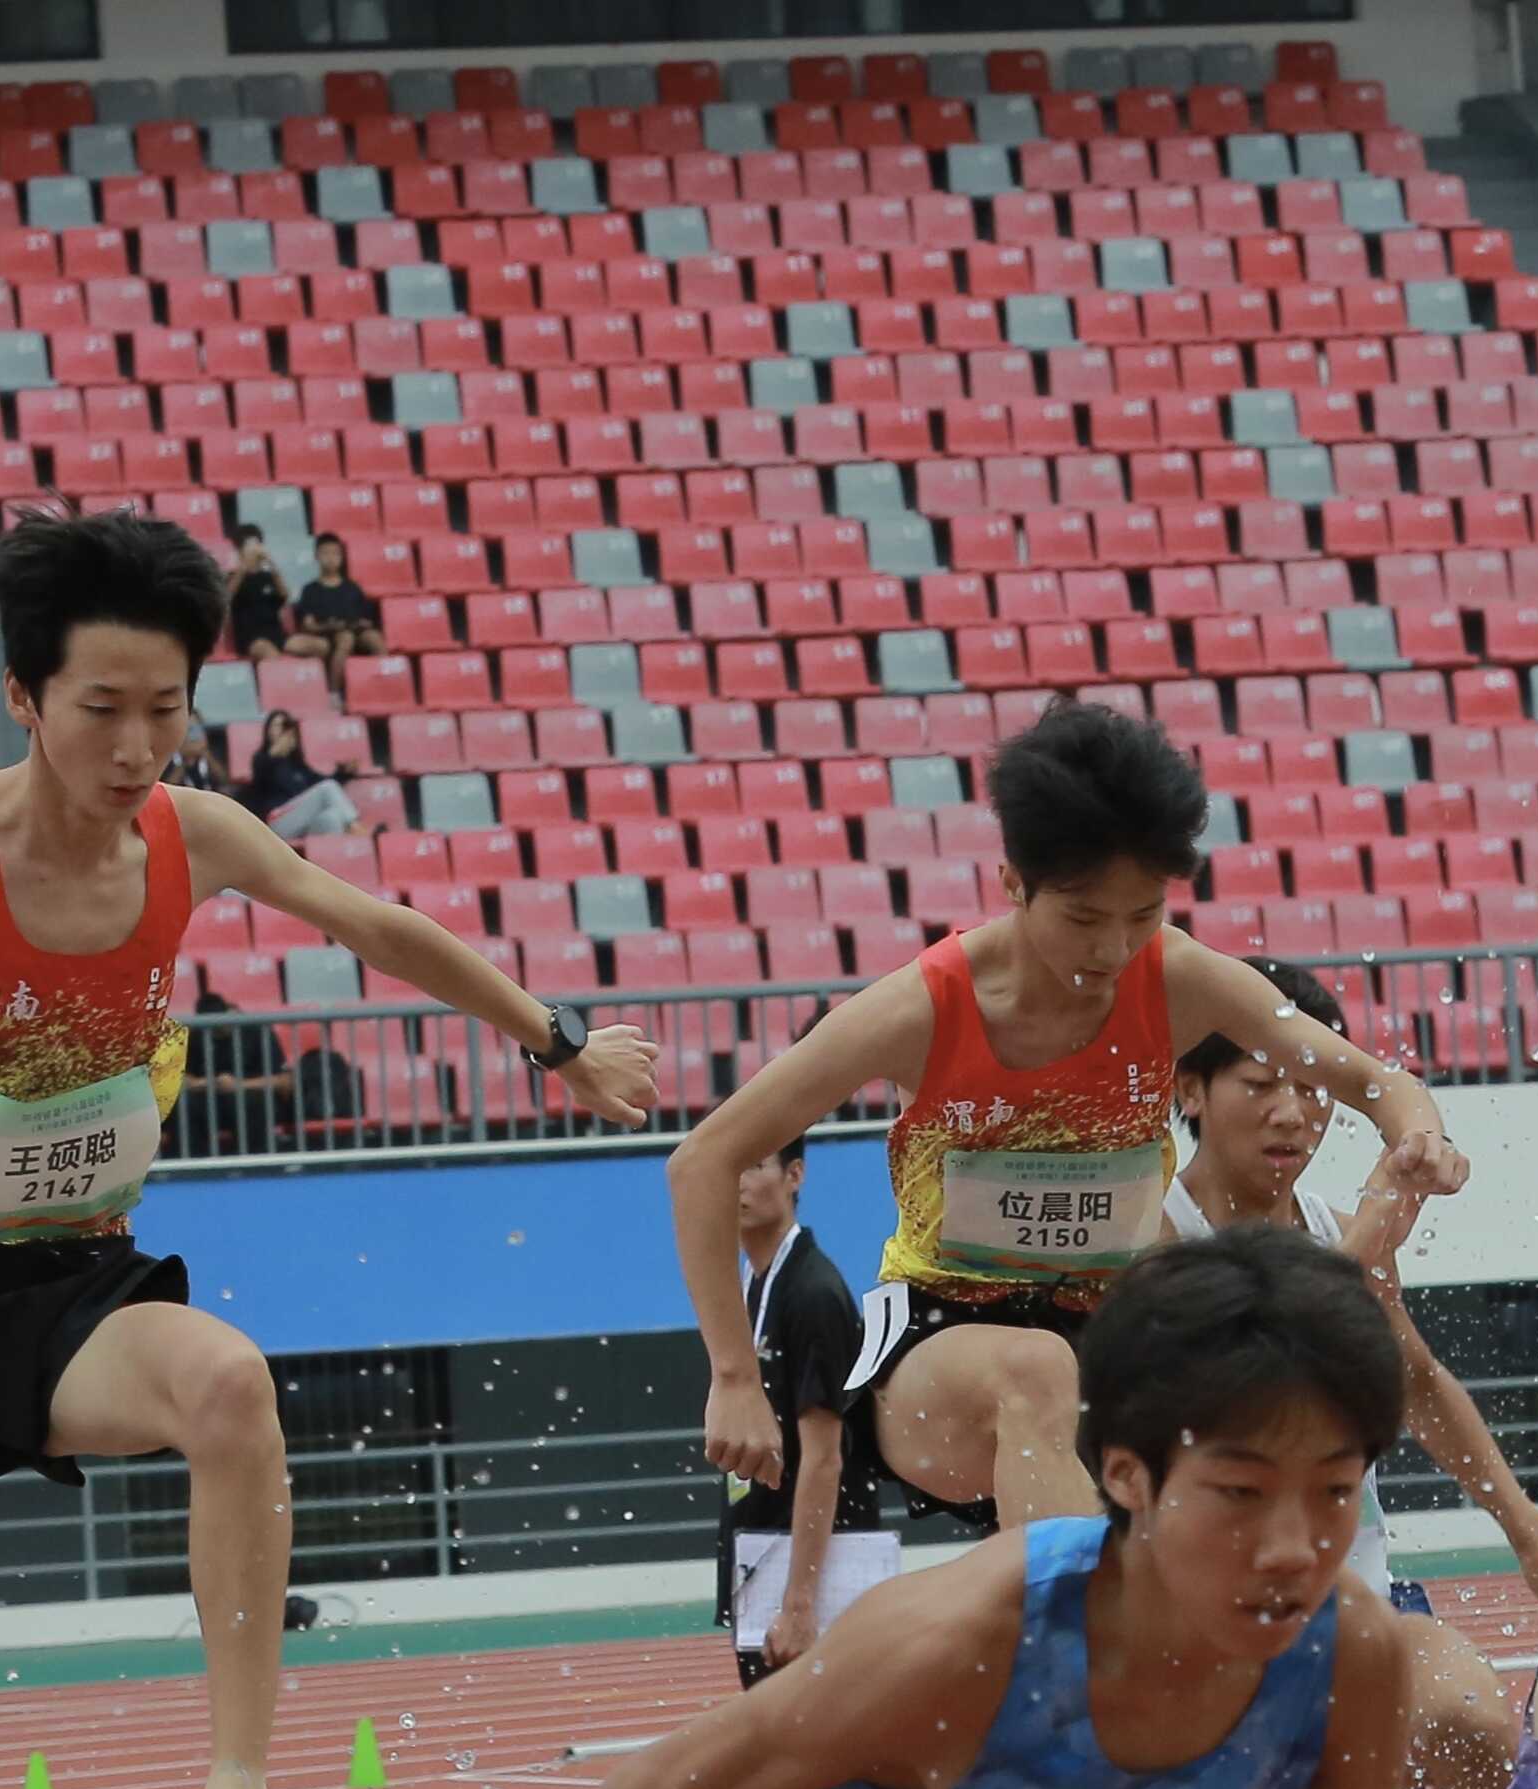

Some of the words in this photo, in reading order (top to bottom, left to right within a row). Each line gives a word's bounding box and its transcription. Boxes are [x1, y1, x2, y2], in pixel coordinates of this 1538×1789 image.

[943, 1095, 1016, 1134] 渭南
[4, 1128, 117, 1177] 王硕聪
[20, 1174, 95, 1202] 2147
[998, 1189, 1113, 1223] 位晨阳
[1016, 1226, 1089, 1248] 2150
